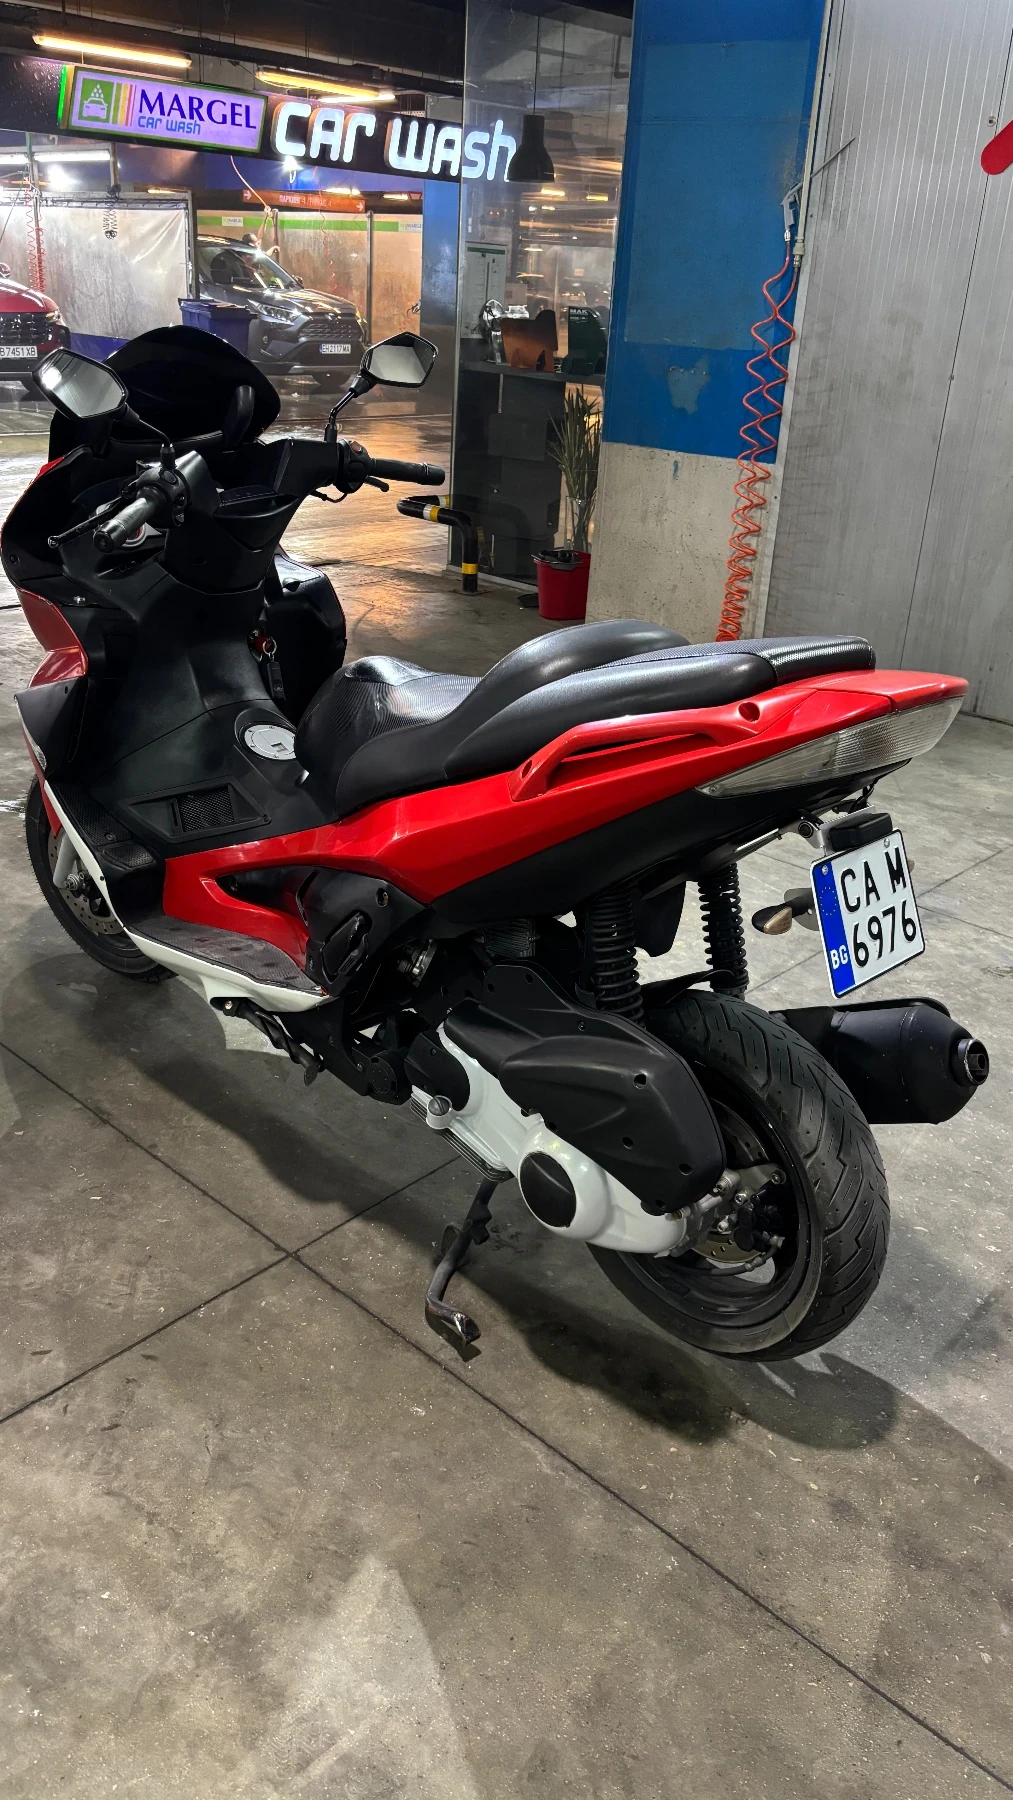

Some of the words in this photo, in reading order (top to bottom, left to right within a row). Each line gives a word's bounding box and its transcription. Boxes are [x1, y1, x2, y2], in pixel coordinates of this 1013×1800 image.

[138, 88, 257, 130] MARGEL
[569, 308, 588, 316] MAK
[840, 859, 881, 914] CA
[883, 846, 907, 895] M
[852, 899, 917, 968] 6976
[829, 944, 849, 970] BG
